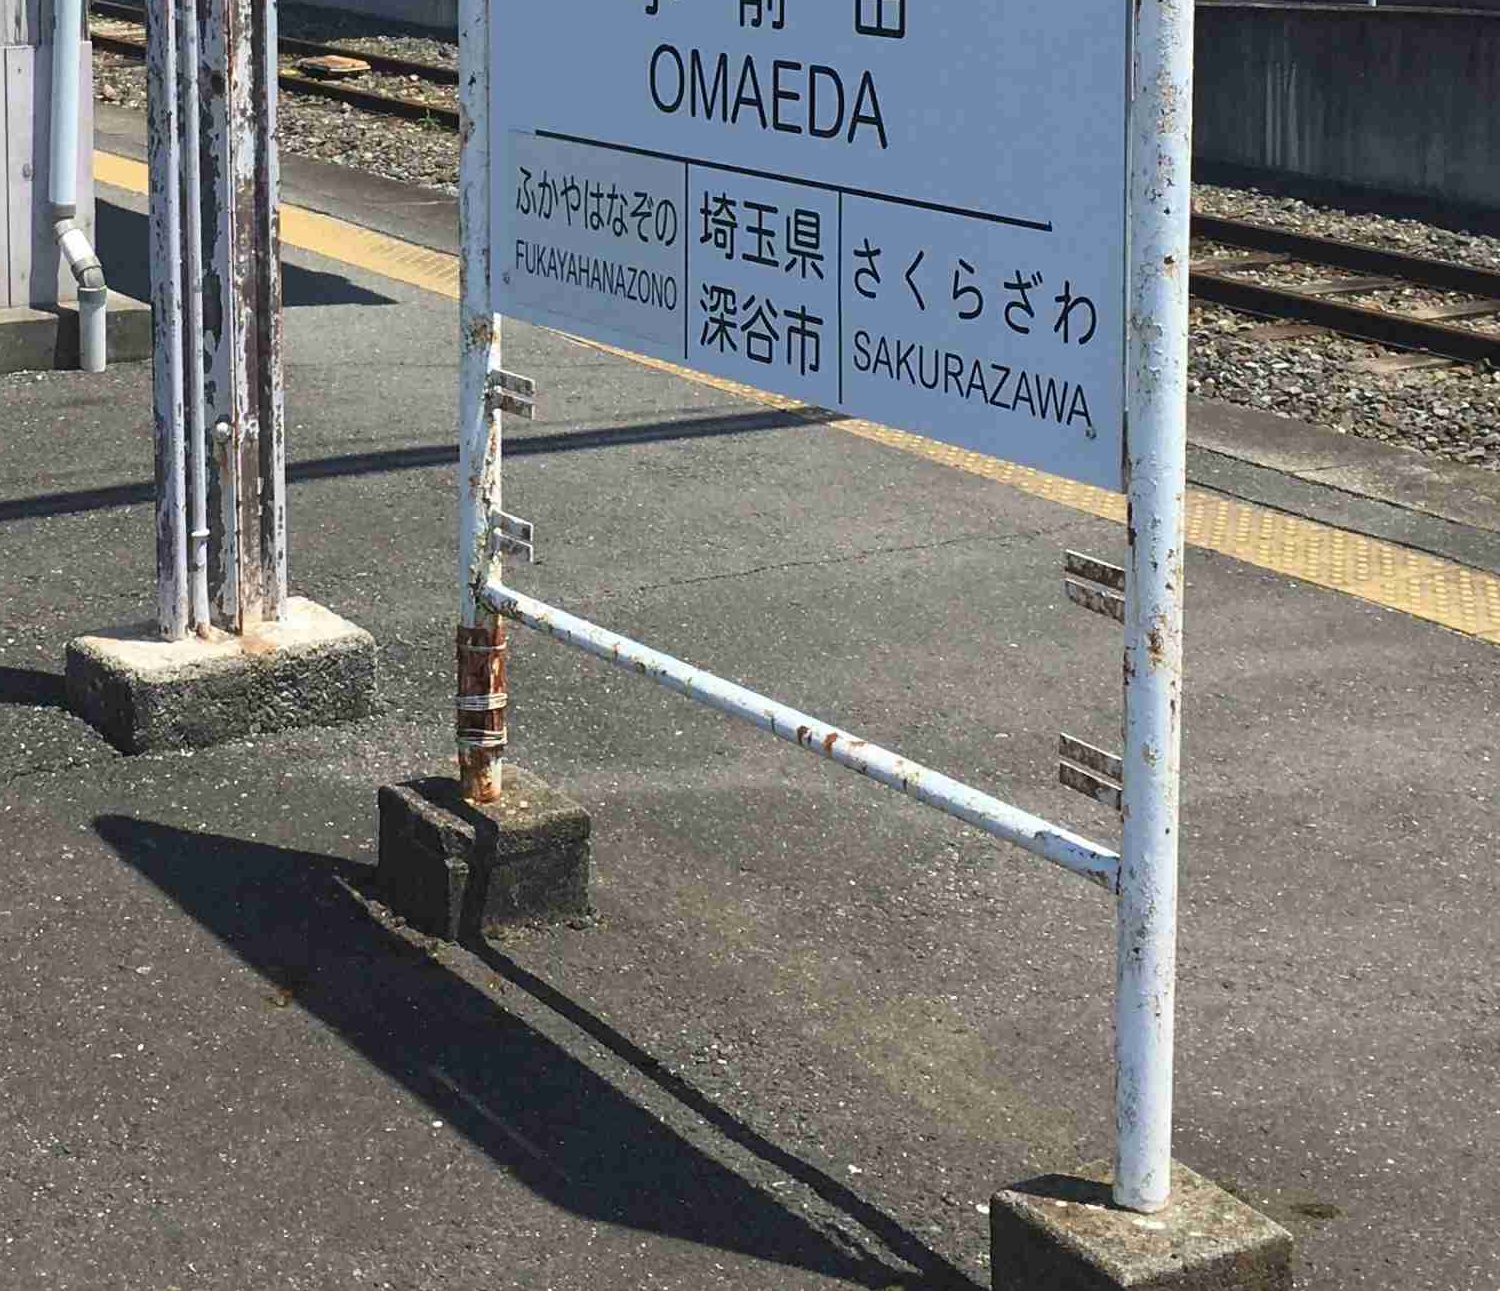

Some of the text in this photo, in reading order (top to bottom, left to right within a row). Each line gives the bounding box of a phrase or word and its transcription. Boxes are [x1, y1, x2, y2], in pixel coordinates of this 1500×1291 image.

[650, 44, 888, 149] OMAEDA
[515, 167, 678, 247] ふかやはなぞの
[700, 191, 825, 281] 埼玉県
[515, 239, 678, 311] FUKAYAHANAZONO
[853, 238, 1097, 345] さくらざわ
[699, 283, 824, 377] 深谷市
[853, 331, 1093, 429] SAKURAZAWA
